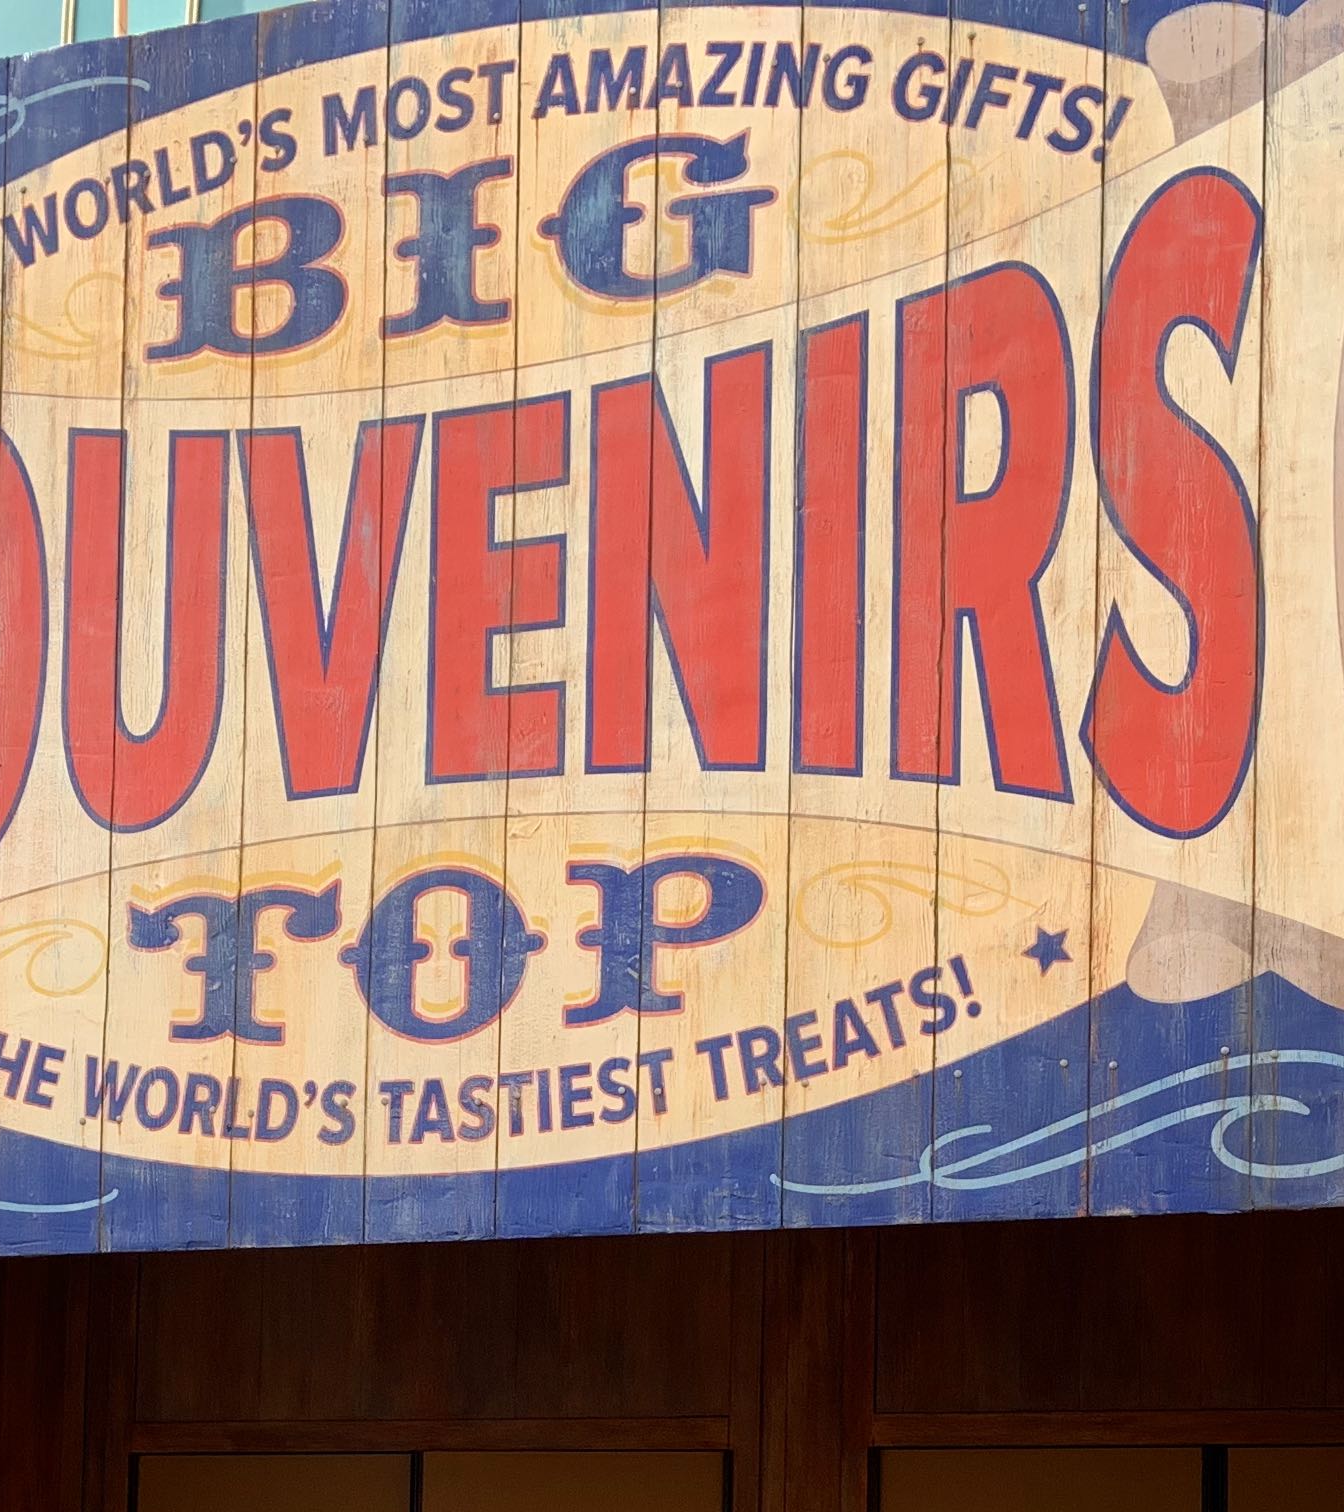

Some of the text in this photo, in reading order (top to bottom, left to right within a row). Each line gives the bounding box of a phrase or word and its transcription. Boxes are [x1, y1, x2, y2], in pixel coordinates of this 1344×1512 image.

[0, 107, 299, 270] WORLD'S
[321, 60, 516, 156] MOST
[536, 40, 873, 118] AMAZING
[892, 49, 1133, 162] GIFTS!
[143, 128, 779, 364] BIG
[83, 1055, 359, 1146] WORLD'S
[380, 1049, 677, 1146] TASTIEST
[696, 954, 983, 1103] TREATS!
[127, 852, 768, 1047] TOP
